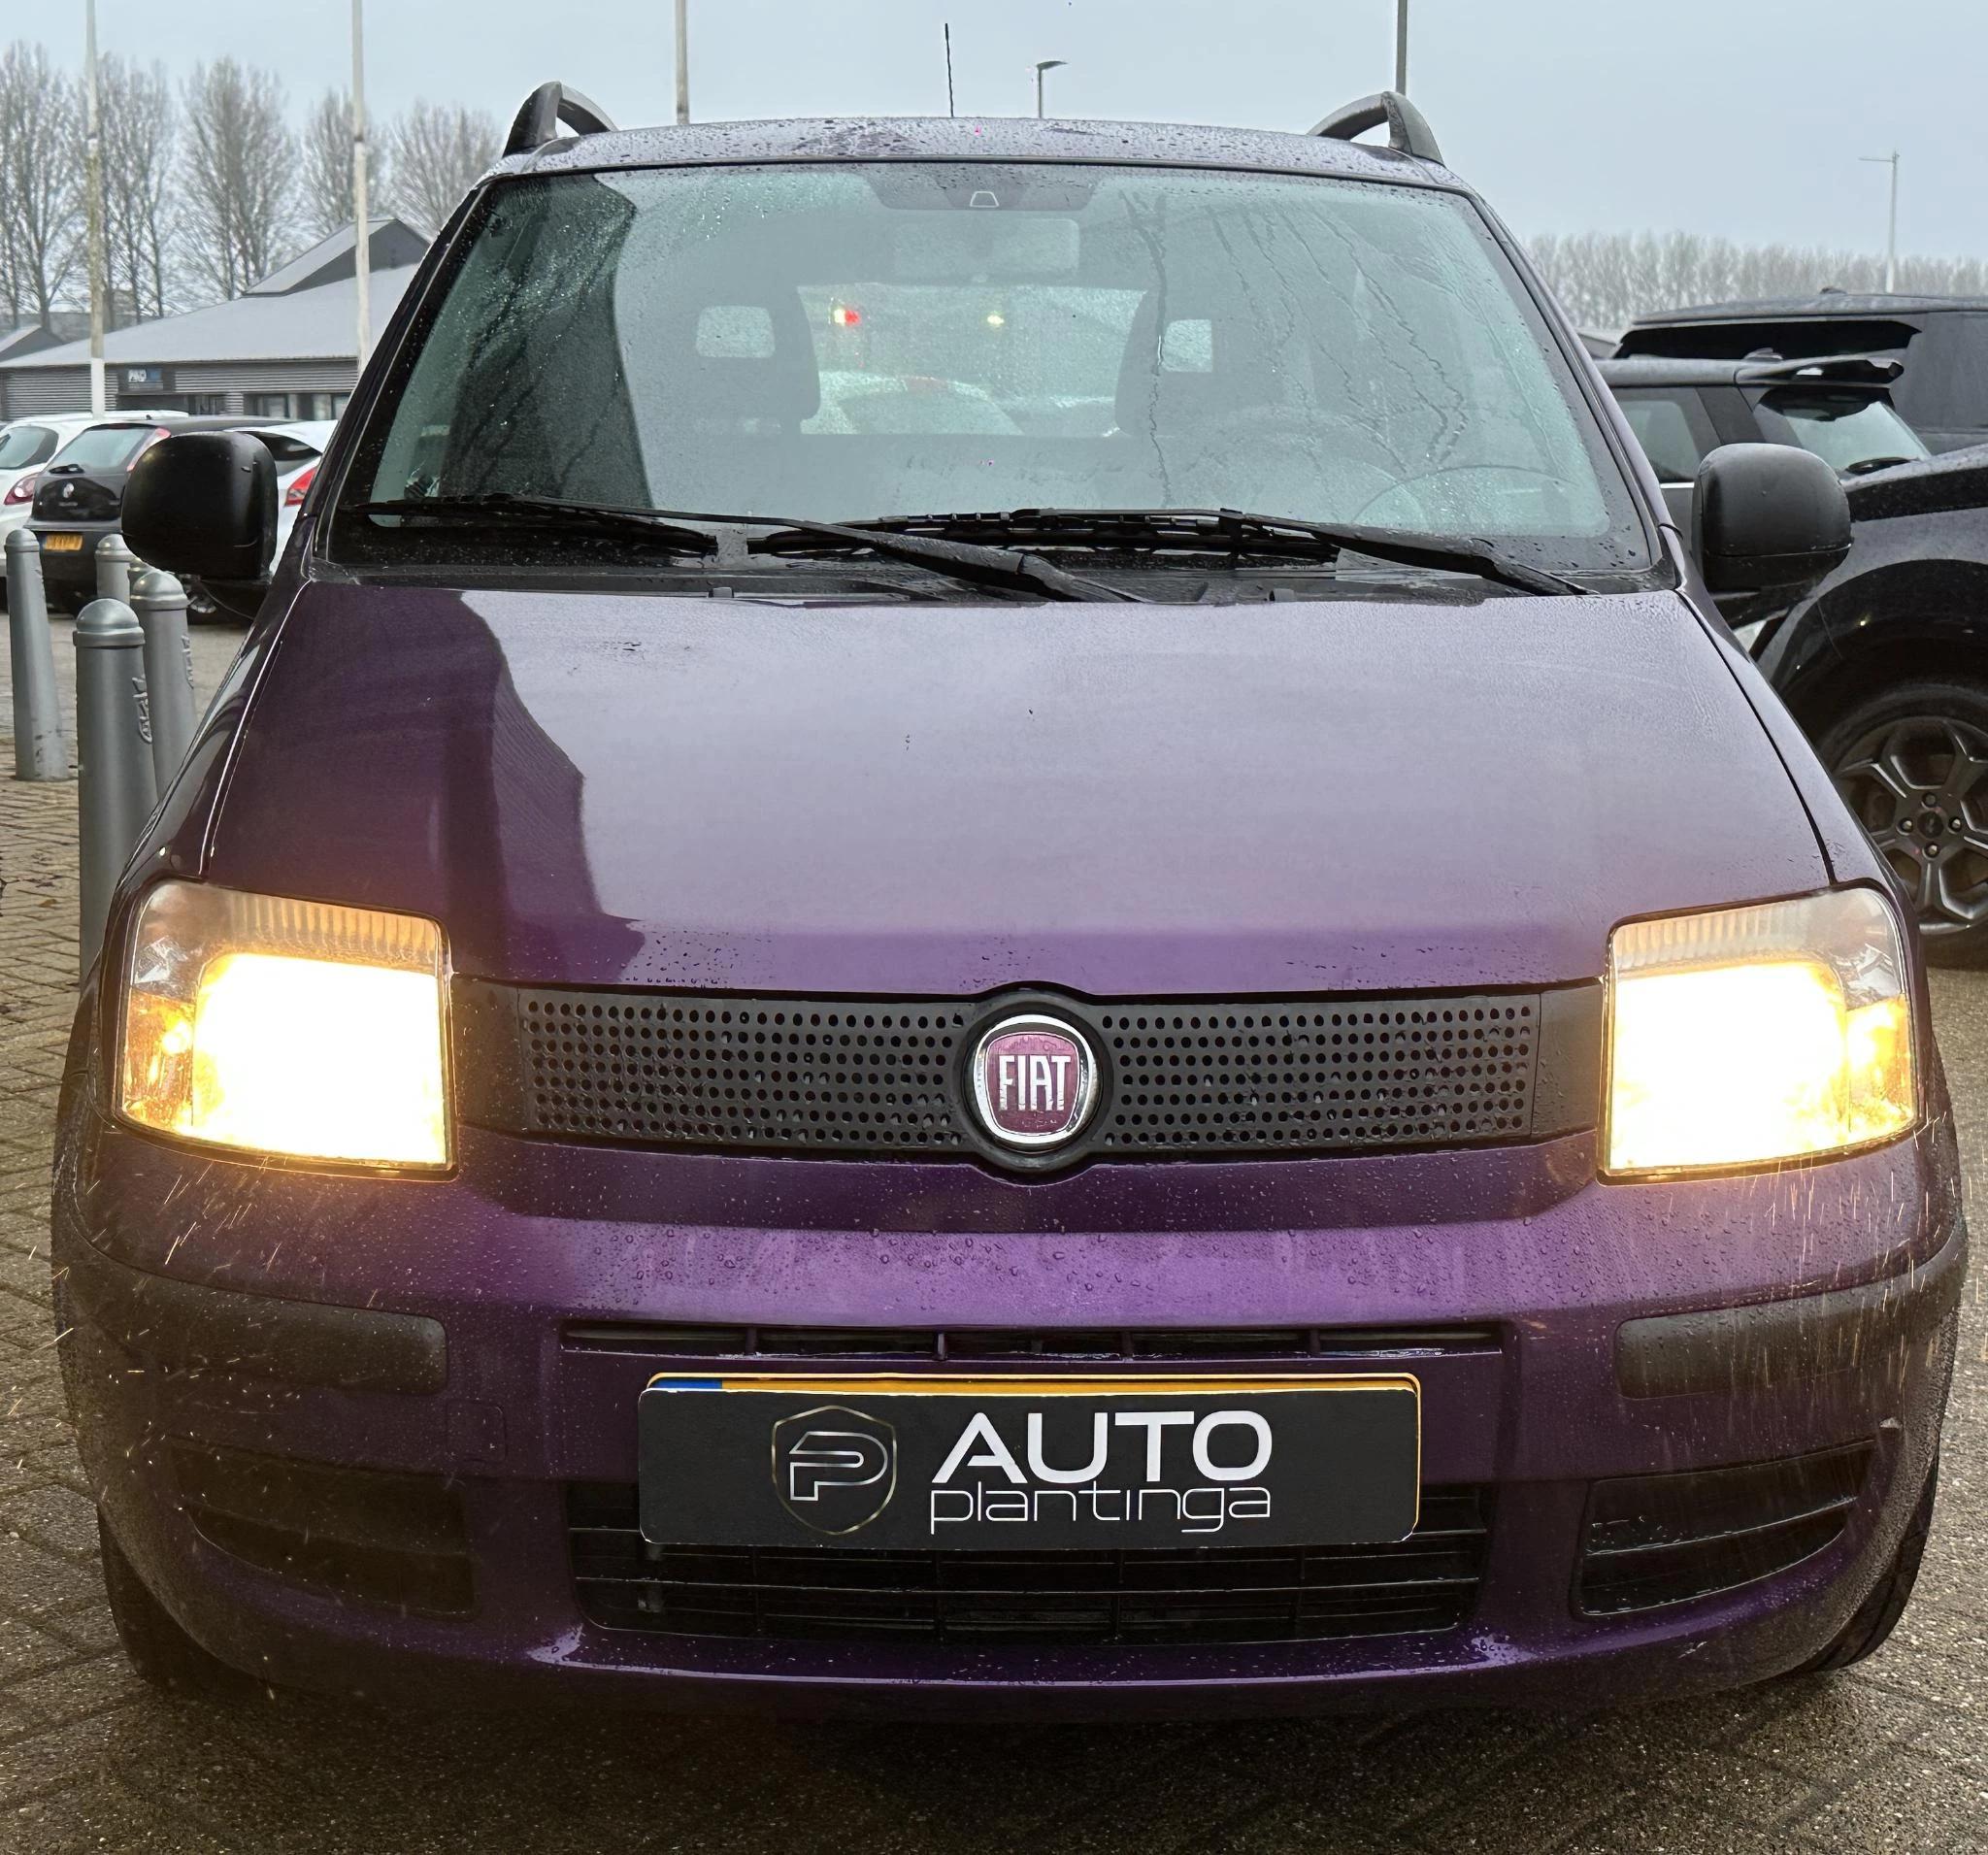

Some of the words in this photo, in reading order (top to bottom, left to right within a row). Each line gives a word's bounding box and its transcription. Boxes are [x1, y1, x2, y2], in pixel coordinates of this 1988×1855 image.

[998, 1054, 1072, 1111] FIAT
[932, 1410, 1273, 1484] AUTO
[930, 1481, 1272, 1536] plantinga
